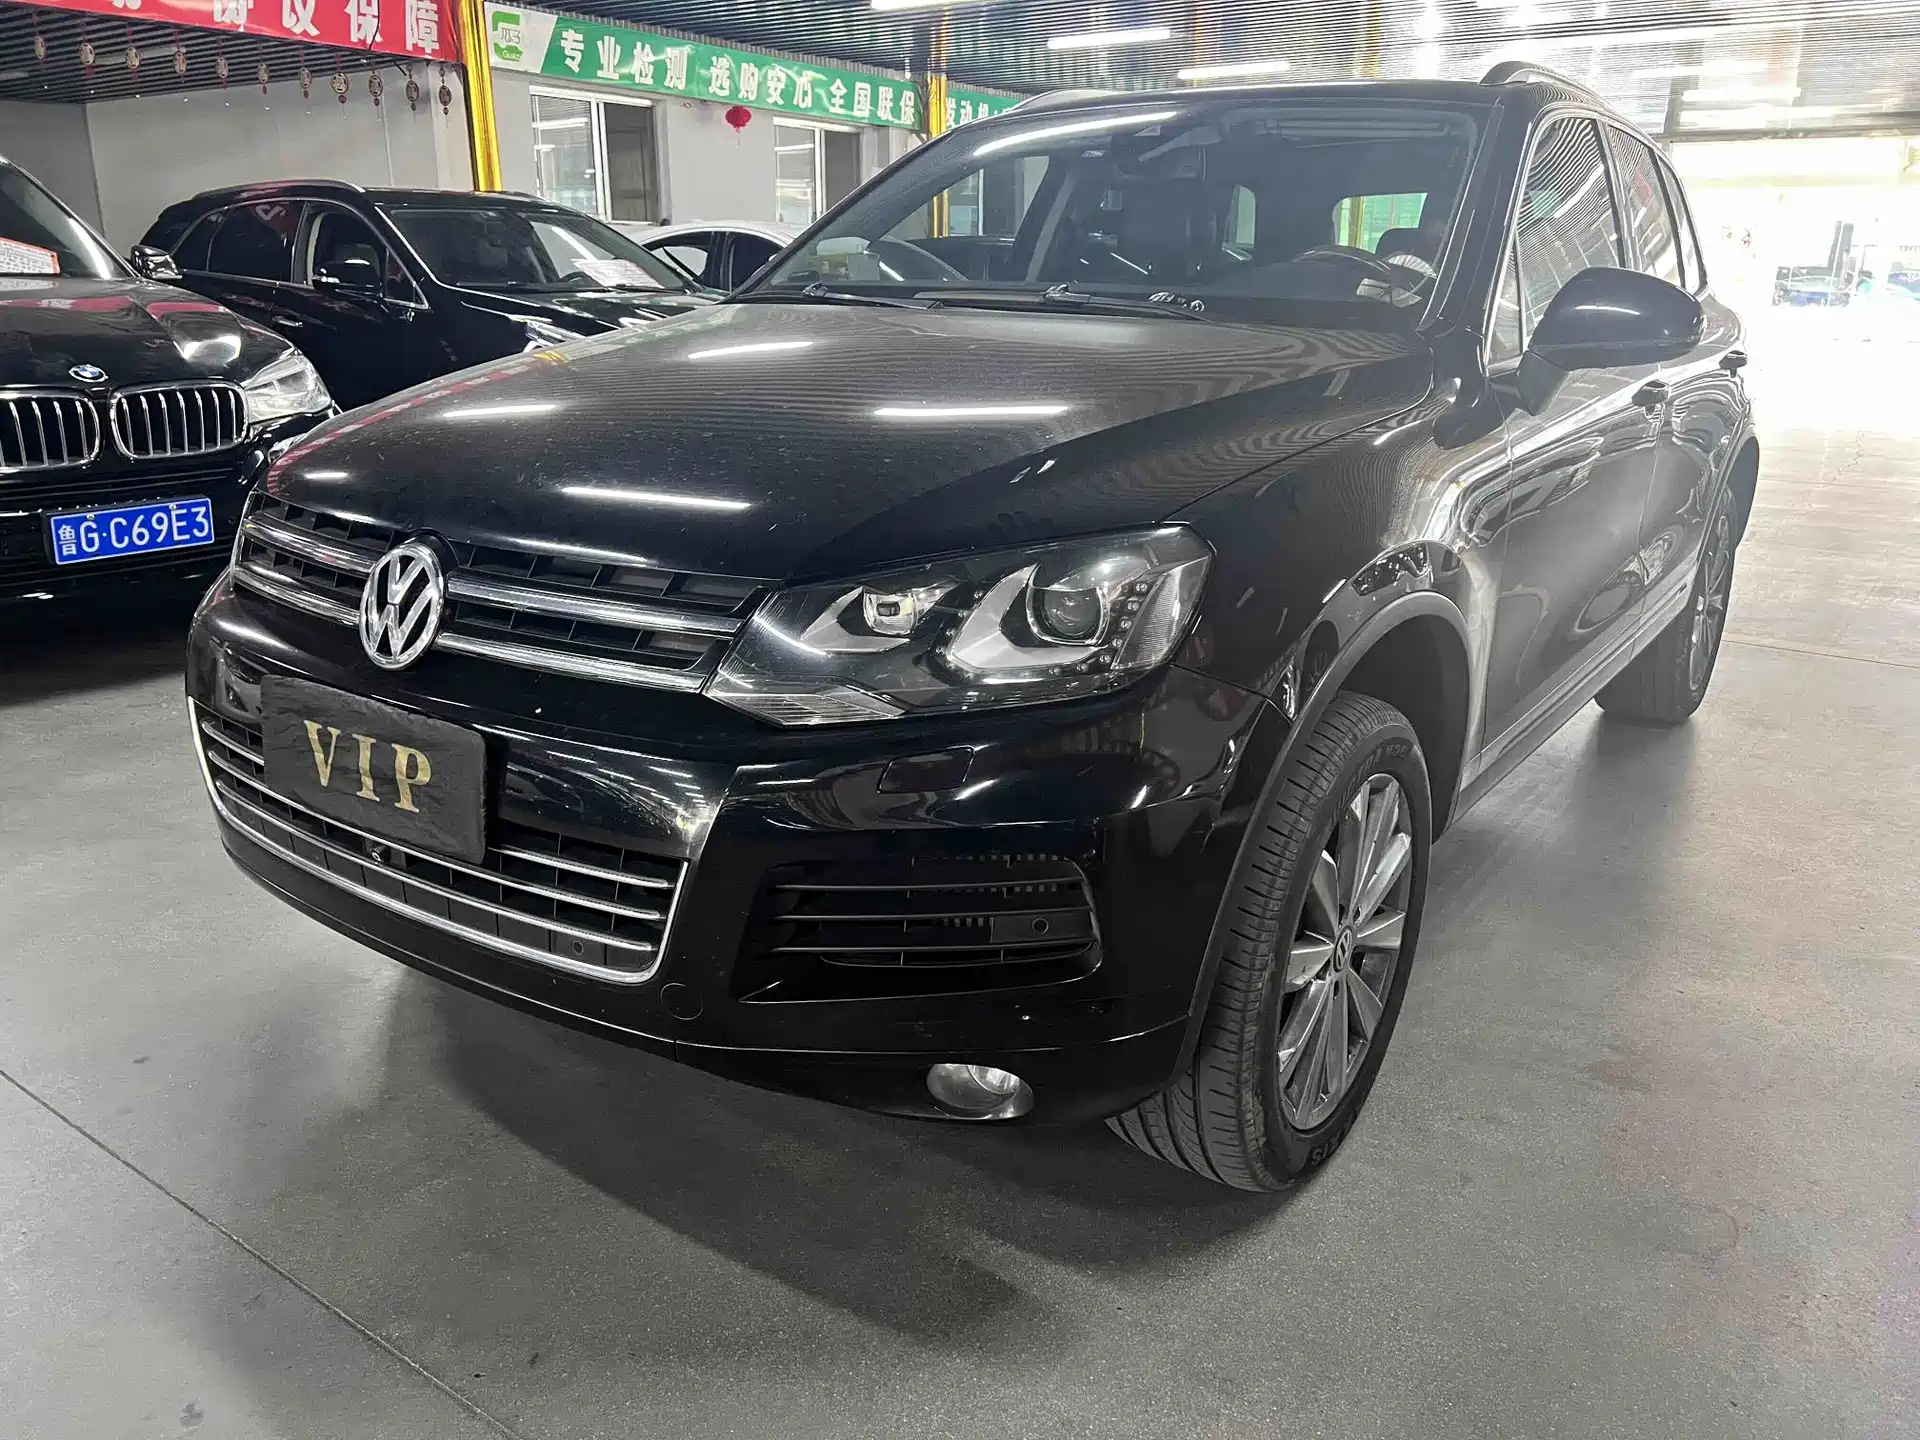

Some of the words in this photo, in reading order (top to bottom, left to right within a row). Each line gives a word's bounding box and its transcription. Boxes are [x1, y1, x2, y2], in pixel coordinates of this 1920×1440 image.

[560, 29, 692, 90] 专业检测
[829, 78, 915, 125] 全国联保
[303, 719, 433, 814] VIP
